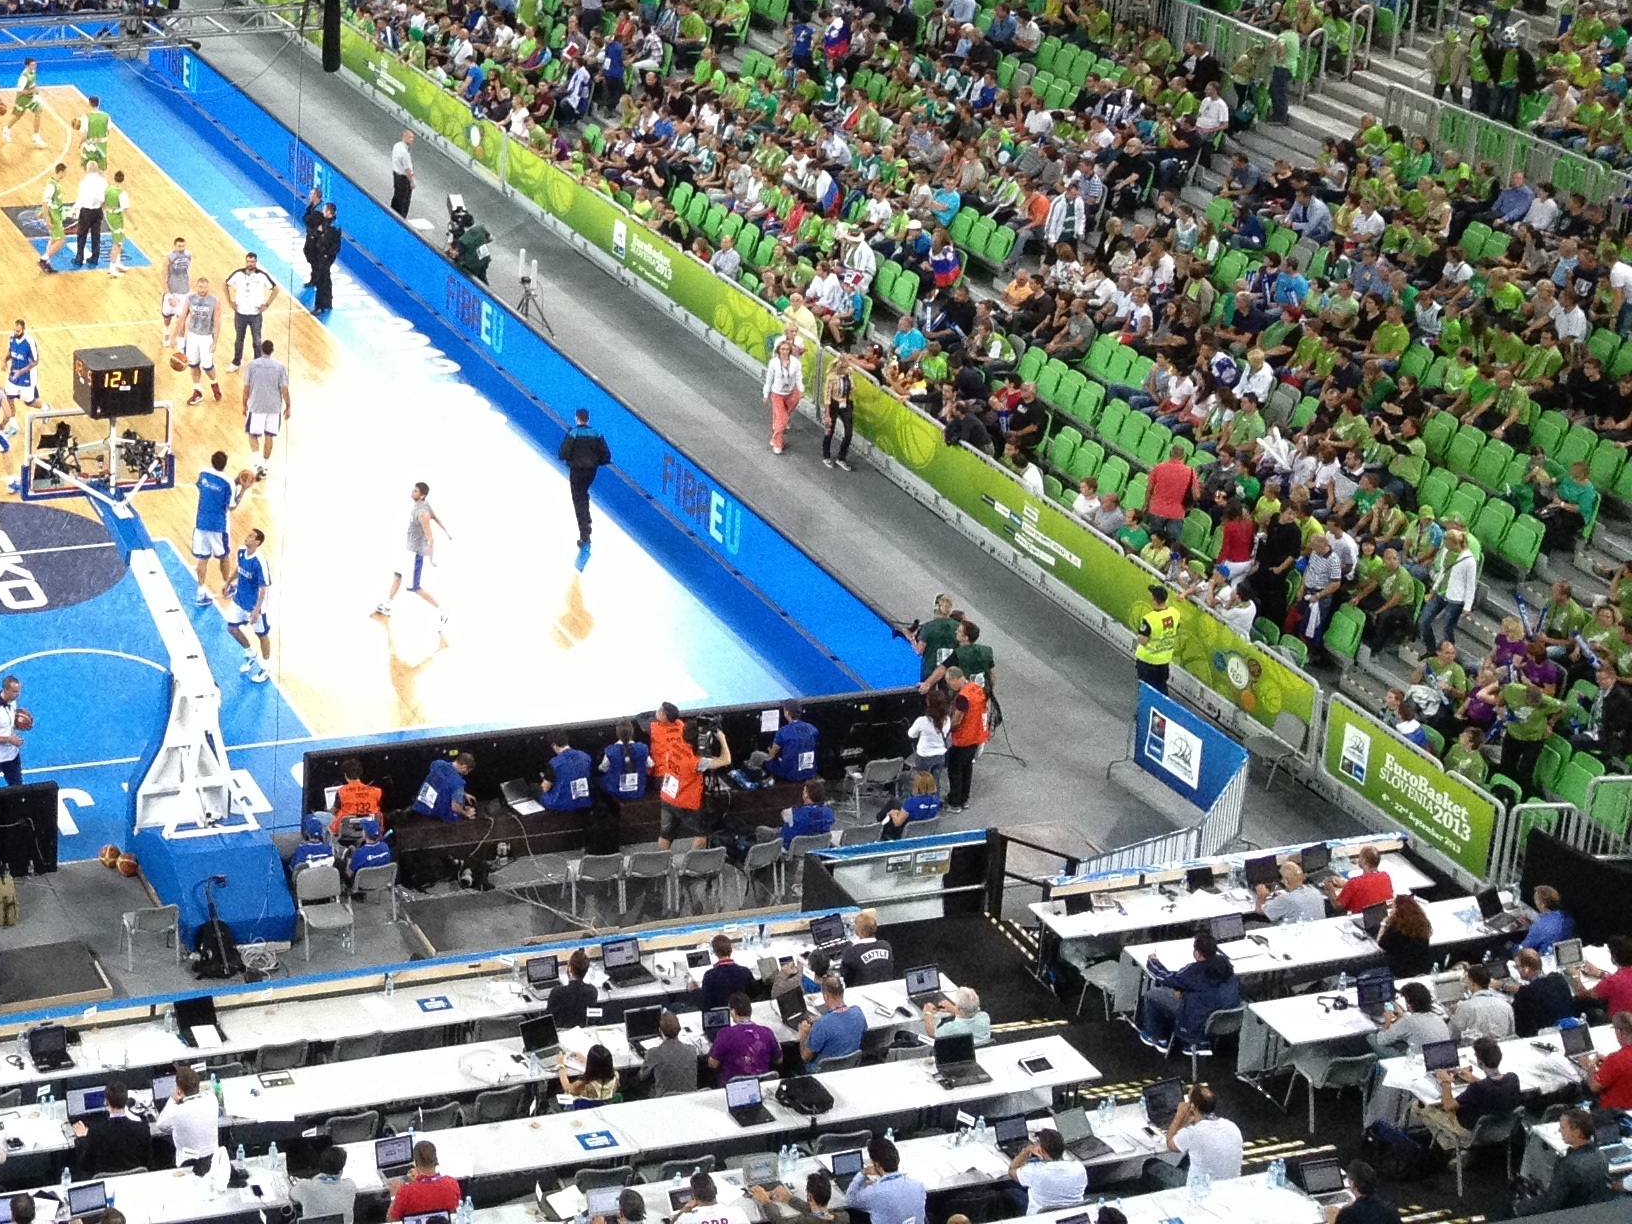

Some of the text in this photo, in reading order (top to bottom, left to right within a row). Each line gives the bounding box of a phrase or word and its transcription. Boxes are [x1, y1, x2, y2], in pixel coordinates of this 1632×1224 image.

[446, 276, 504, 354] FIBAEU
[662, 453, 741, 555] FIBAEU
[355, 802, 370, 814] 132
[1379, 767, 1472, 842] SLOVENIA 2013
[1385, 753, 1469, 821] EuroBasket
[1409, 811, 1444, 842] September
[1443, 839, 1461, 854] 2013
